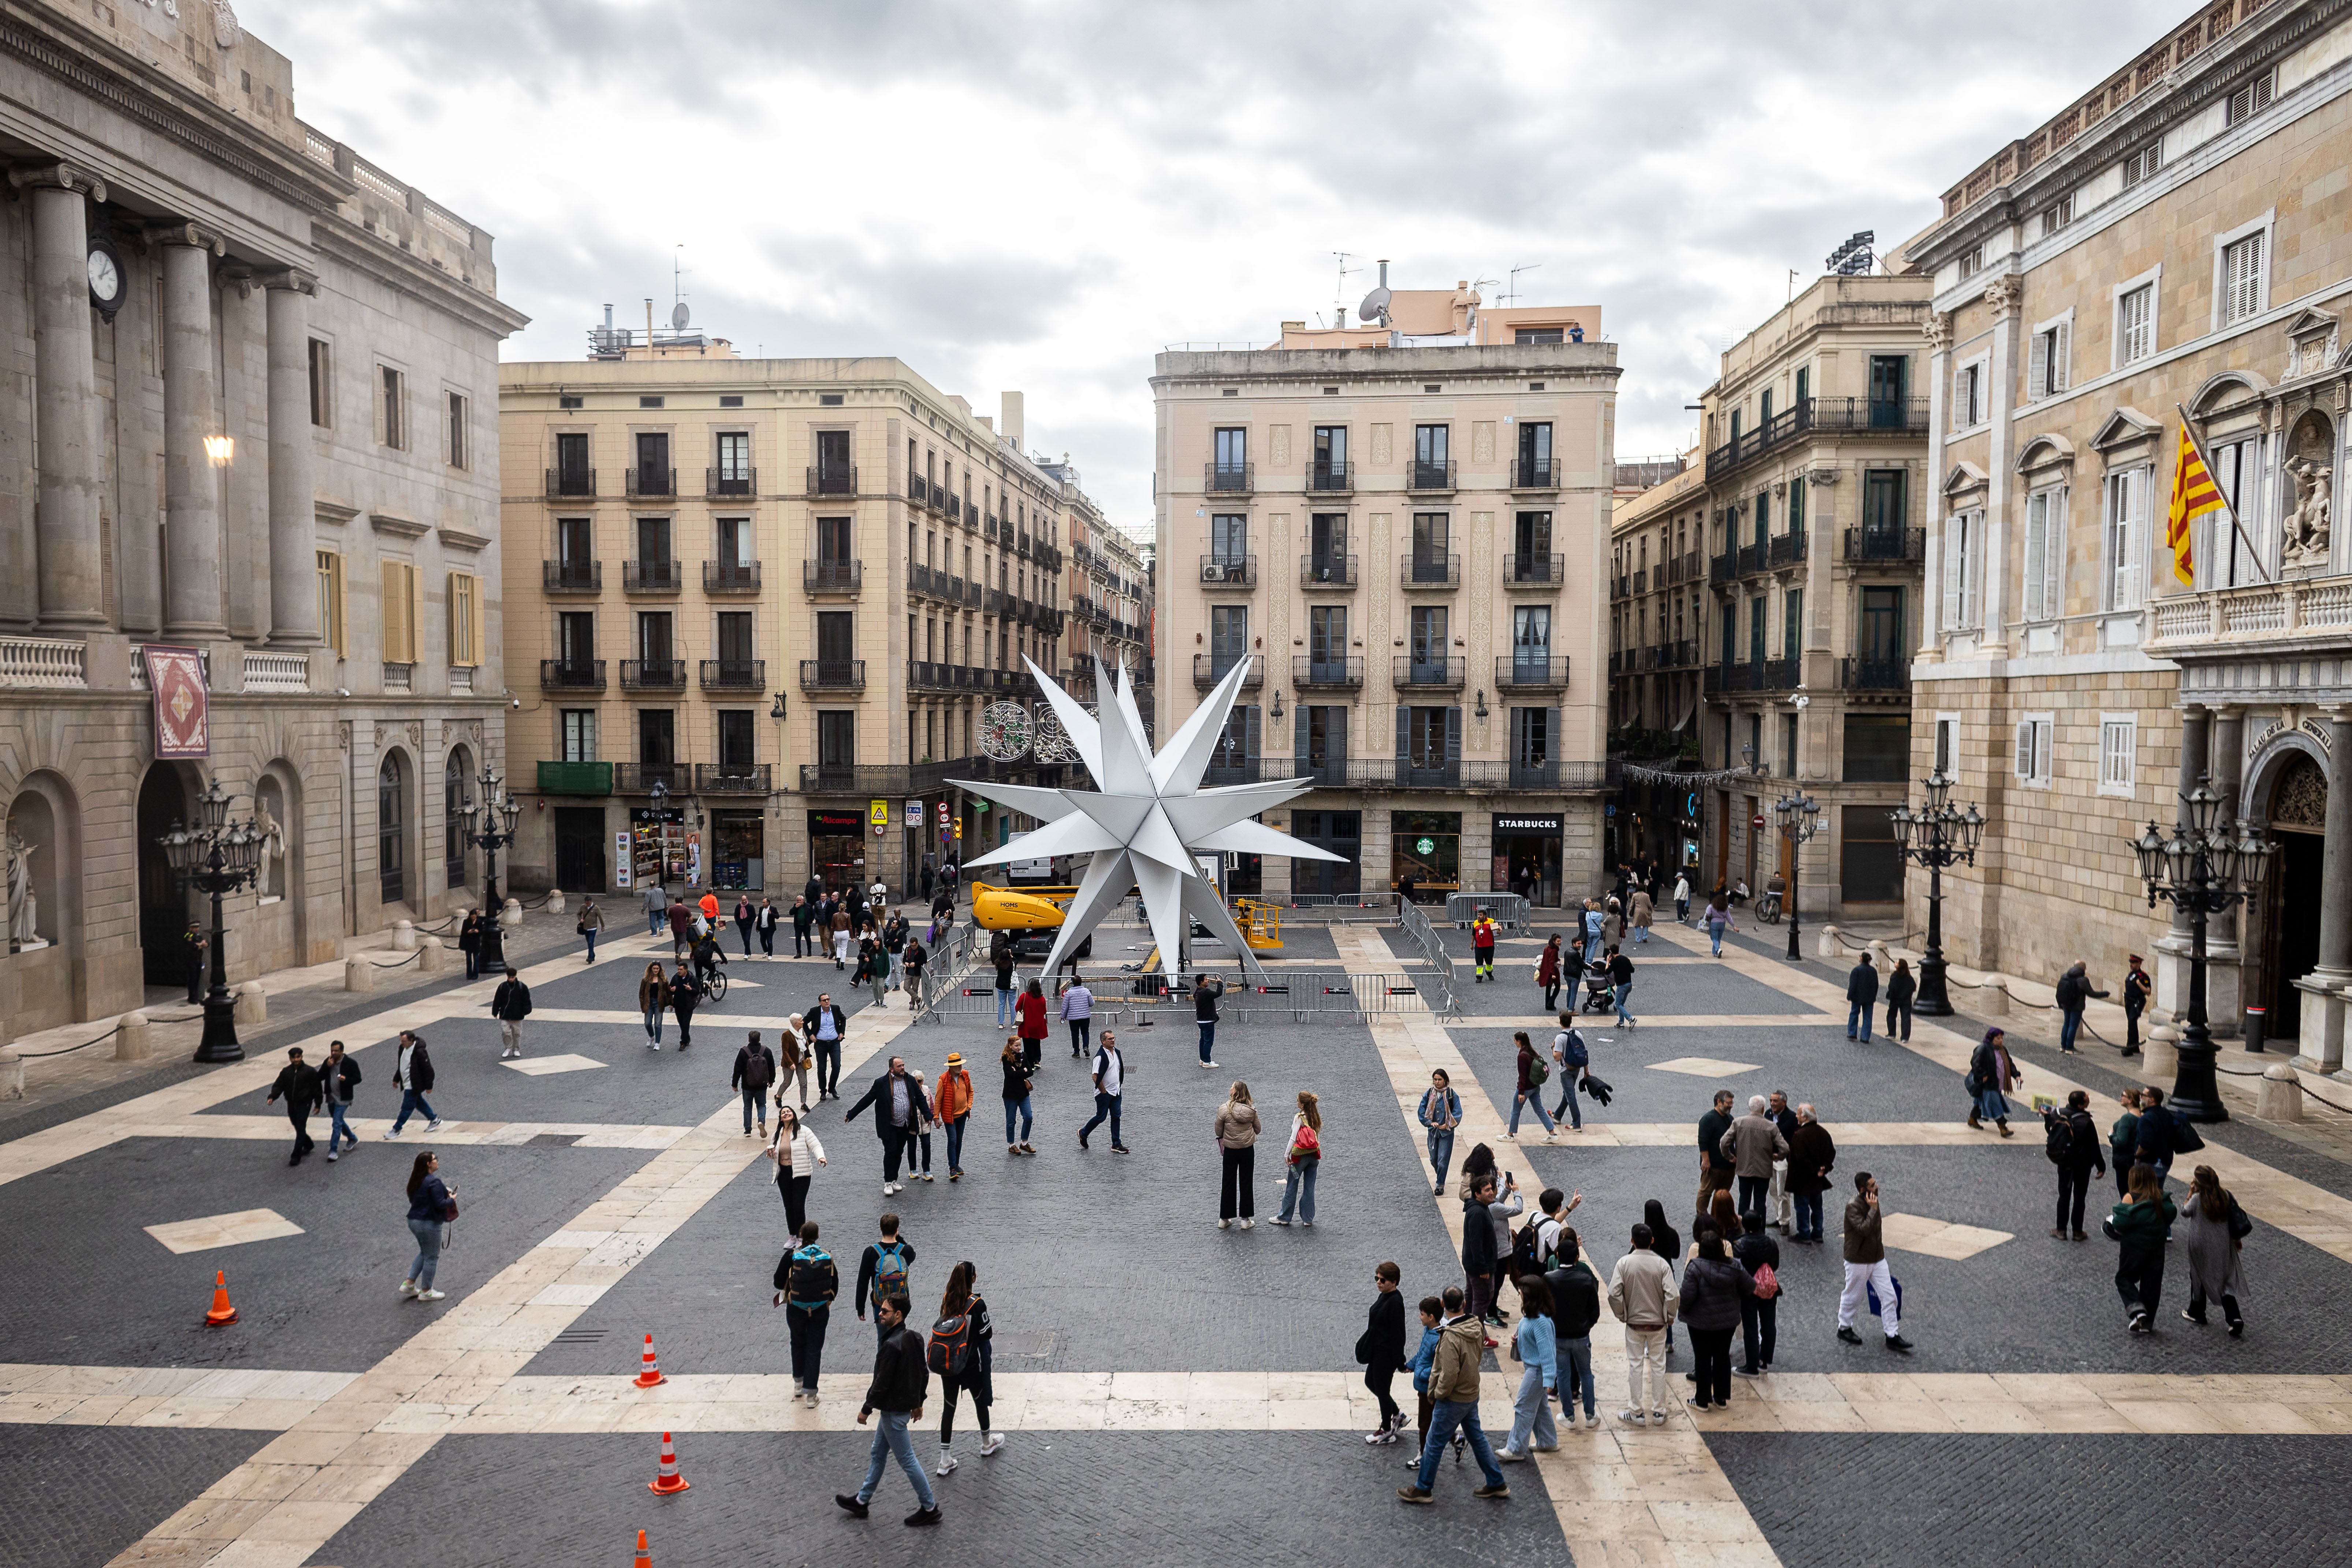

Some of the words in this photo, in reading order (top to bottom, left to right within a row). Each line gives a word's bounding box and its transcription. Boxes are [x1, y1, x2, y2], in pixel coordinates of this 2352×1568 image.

[2249, 734, 2265, 761] PALAU
[2266, 725, 2275, 737] DE
[2276, 720, 2285, 730] LA
[822, 816, 856, 825] Alcampo
